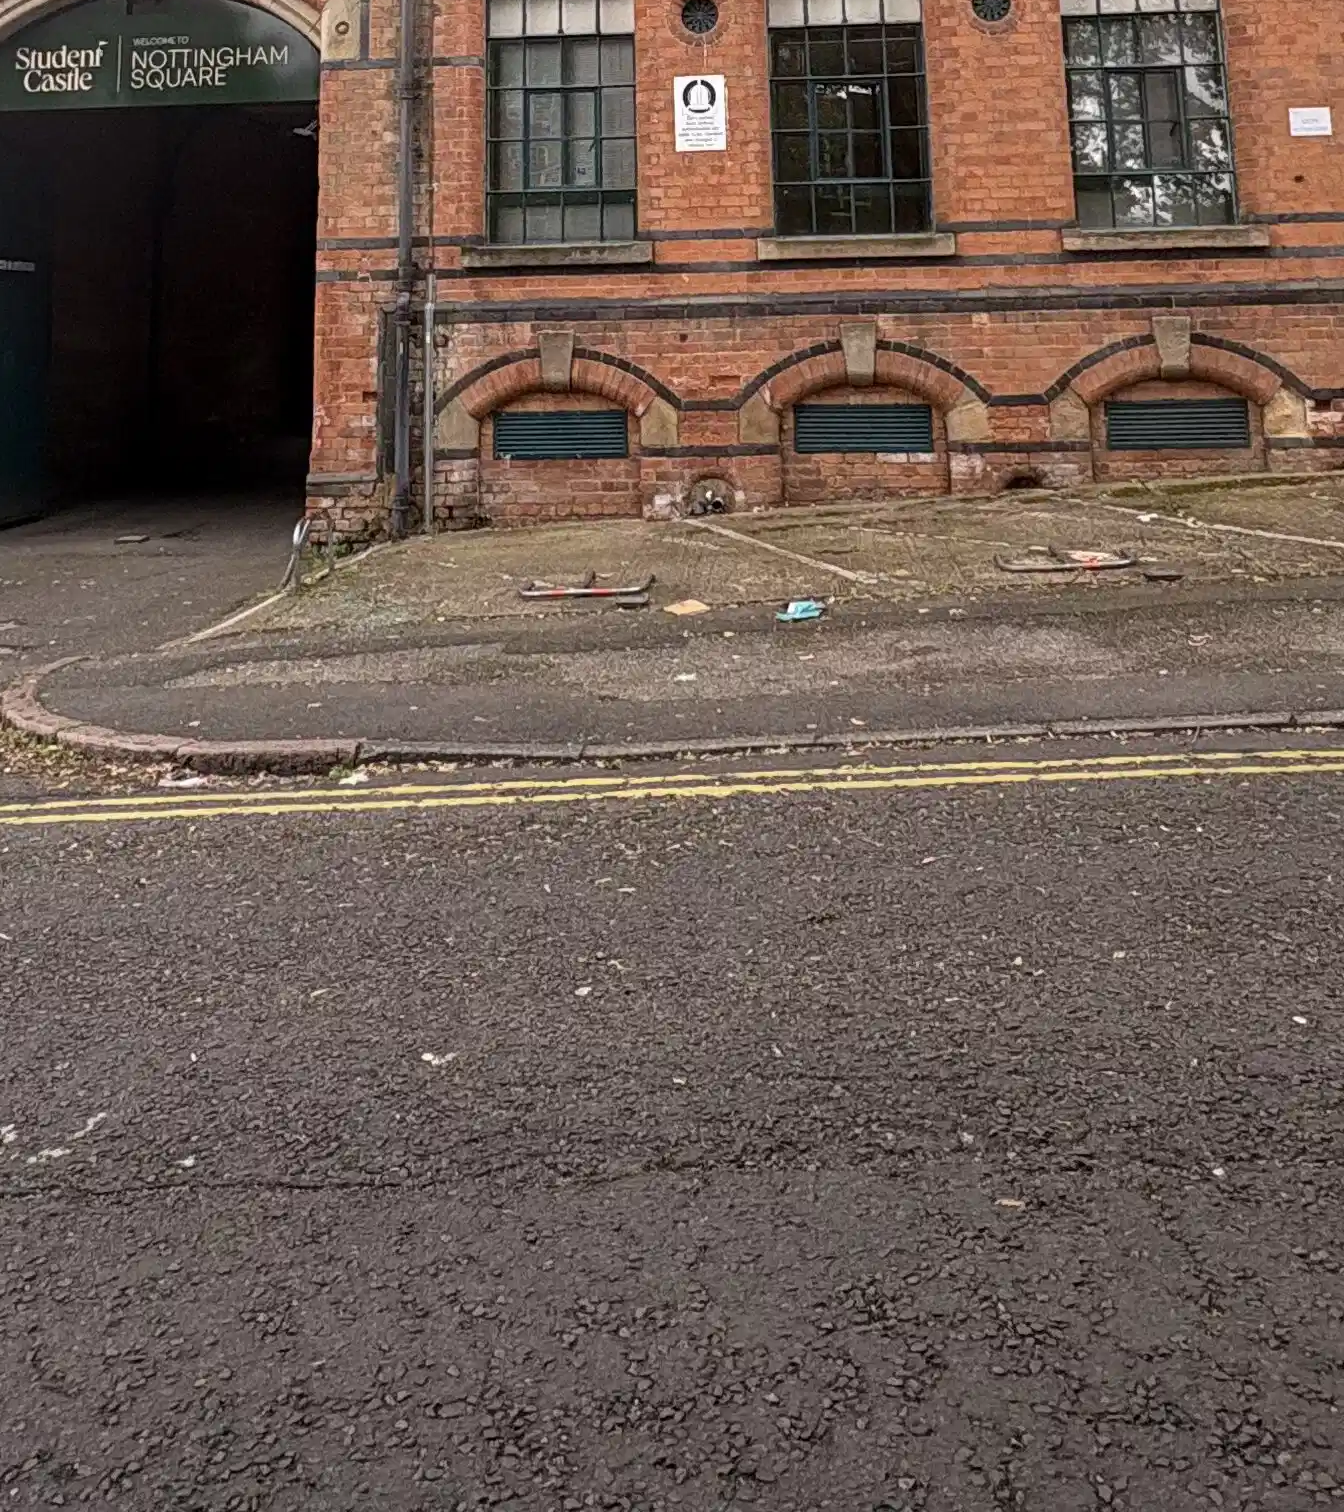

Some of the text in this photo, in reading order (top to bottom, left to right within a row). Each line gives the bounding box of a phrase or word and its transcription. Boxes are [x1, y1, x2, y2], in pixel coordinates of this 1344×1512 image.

[132, 35, 190, 47] WELCOME TO
[15, 43, 105, 70] Student
[131, 44, 289, 70] NOTTINGHAM
[23, 67, 93, 93] Castle
[130, 66, 227, 92] SQUARE
